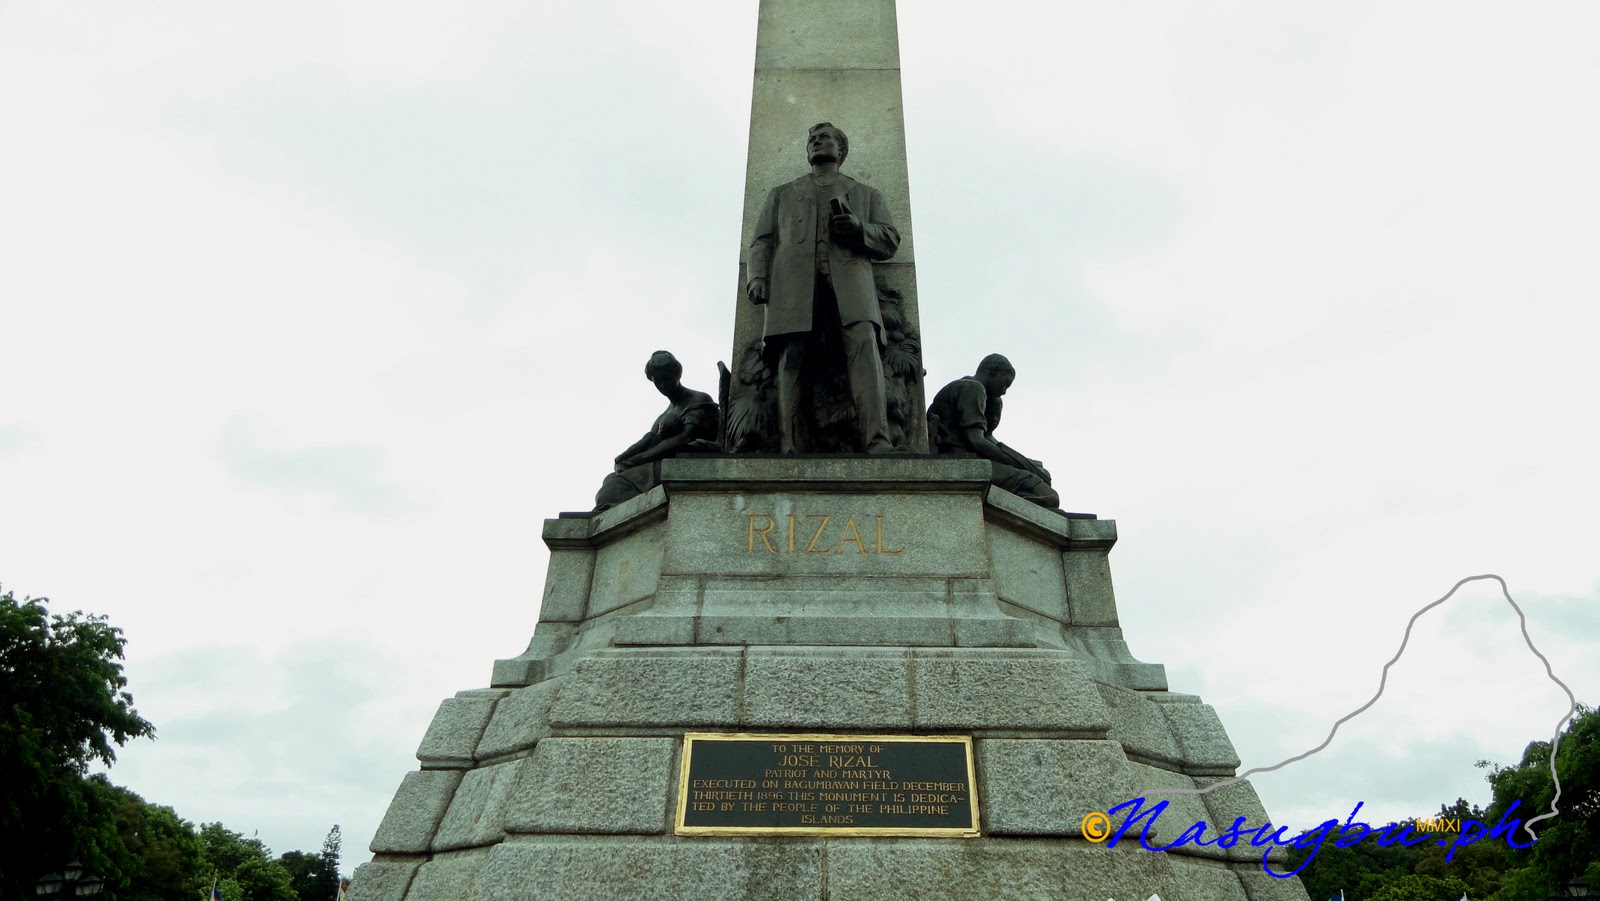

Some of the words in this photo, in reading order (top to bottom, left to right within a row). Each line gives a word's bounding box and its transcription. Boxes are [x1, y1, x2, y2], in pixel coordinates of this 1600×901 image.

[745, 513, 906, 555] RIZAL
[772, 744, 786, 753] TO
[791, 744, 815, 753] THE
[819, 744, 864, 754] MEMORY
[870, 746, 884, 754] OF
[828, 755, 878, 768] RIZAL
[765, 769, 808, 778] PATRIOT
[813, 770, 838, 778] AND
[842, 770, 892, 780] MARTYR
[693, 779, 756, 789] EXECUTED
[762, 780, 779, 789] ON
[784, 780, 859, 790] BAGUMBAYAN
[863, 782, 899, 790] FIELD
[902, 782, 966, 792] DECEMBER
[692, 791, 753, 800] THIRTIETH
[788, 792, 815, 801] THIS
[819, 792, 887, 802] MONUMENT
[893, 793, 905, 802] IS
[911, 794, 965, 803] DEDICA-
[692, 802, 716, 811] TED
[721, 802, 736, 812] BY
[742, 803, 766, 812] THE
[772, 803, 818, 813] PEOPLE
[825, 804, 841, 813] OF
[849, 804, 874, 814] THE
[880, 804, 948, 814] PHILIPPINE
